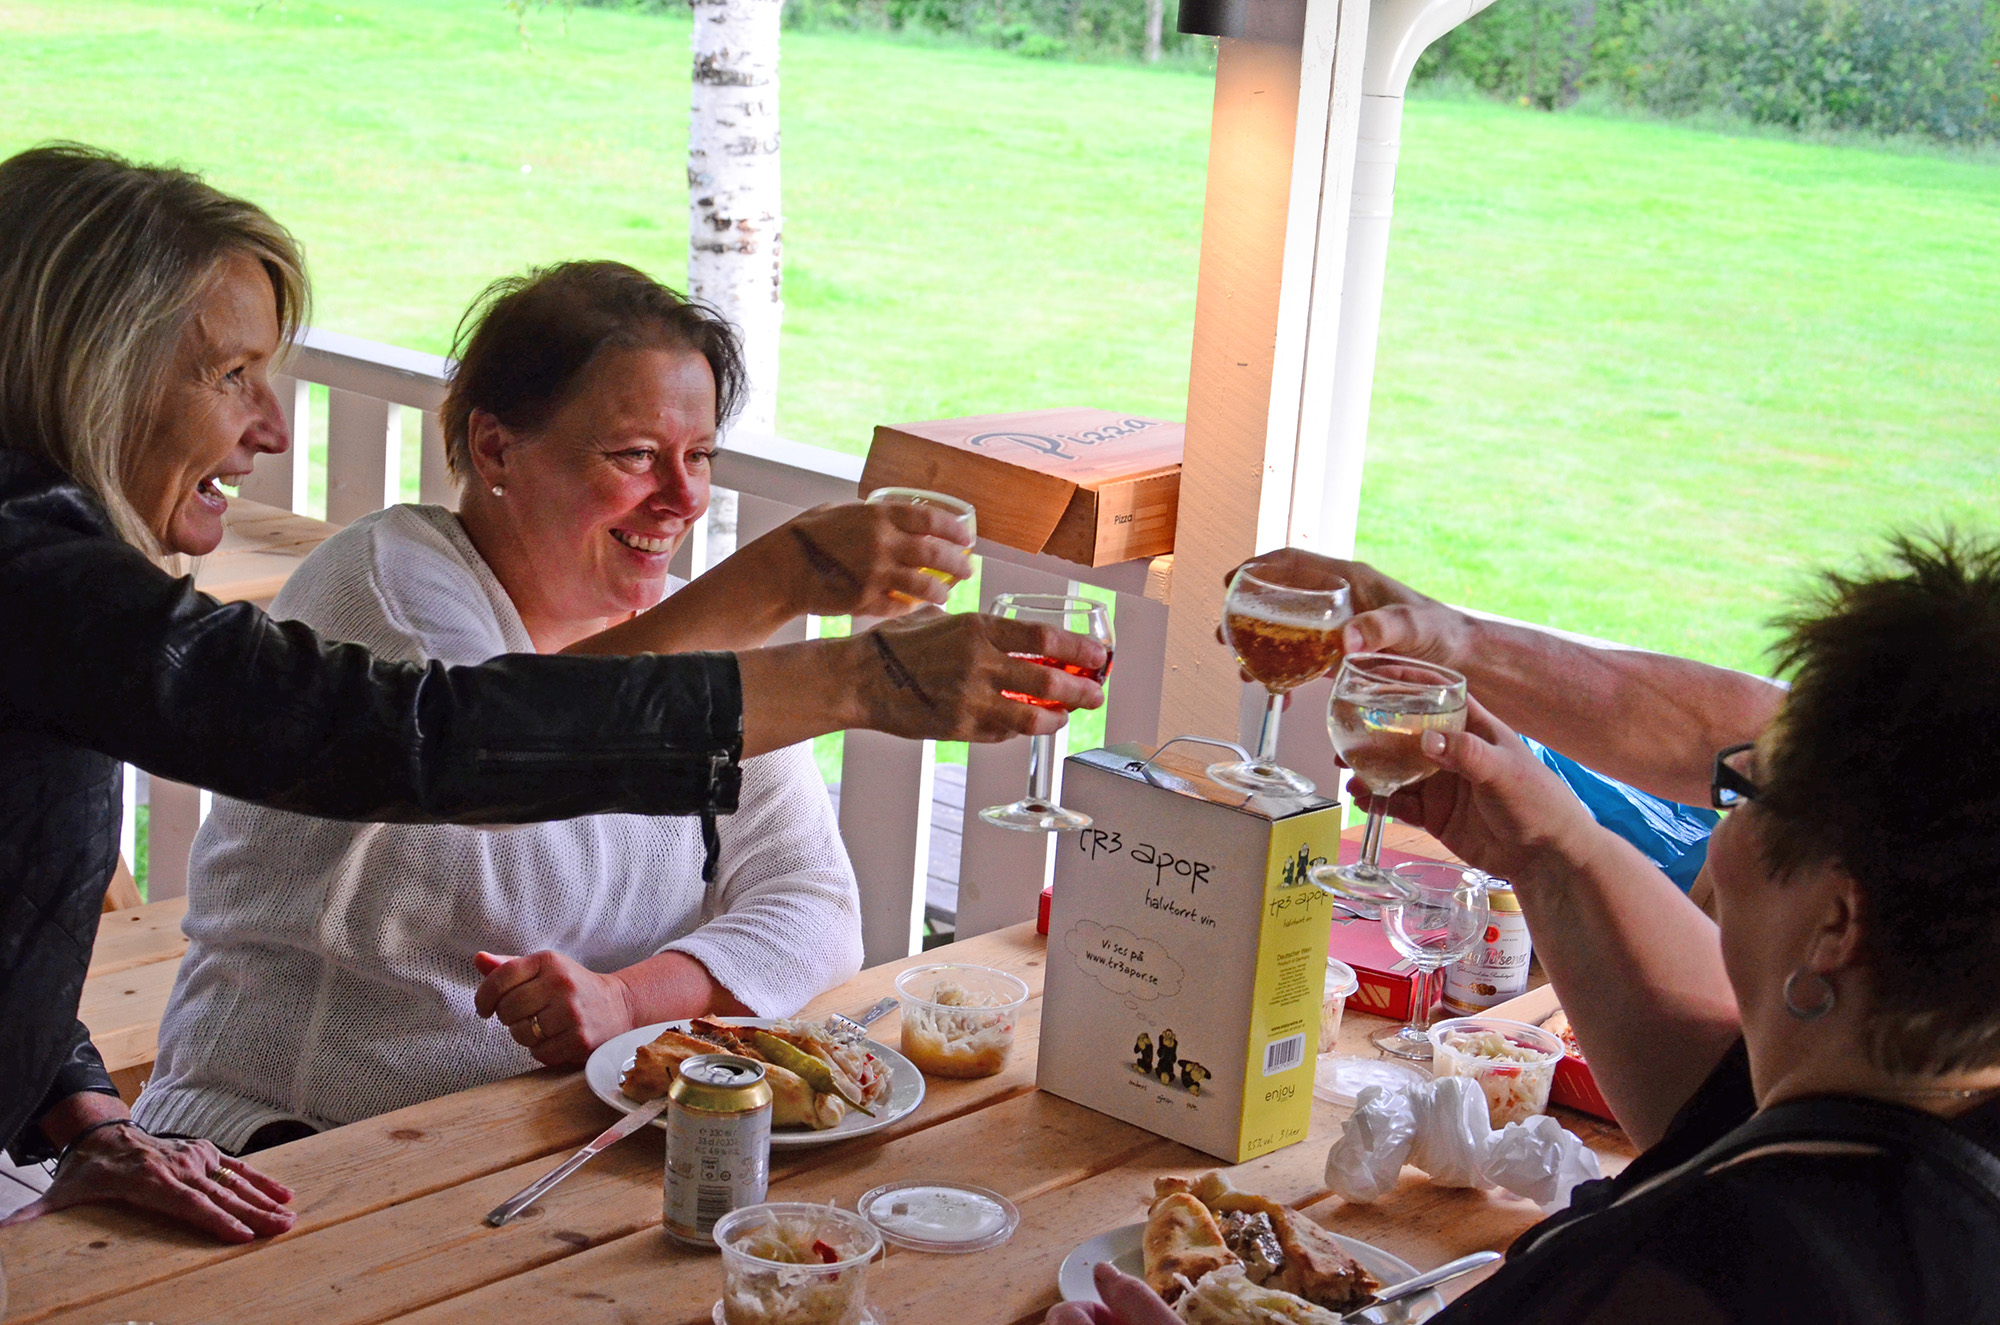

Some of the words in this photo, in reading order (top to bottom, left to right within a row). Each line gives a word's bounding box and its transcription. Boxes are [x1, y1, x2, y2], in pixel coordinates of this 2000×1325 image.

[968, 418, 1159, 462] Pizza
[1114, 513, 1134, 526] Pizza
[1200, 915, 1216, 929] vin
[1113, 943, 1128, 957] ses
[1130, 950, 1144, 963] på
[1483, 947, 1527, 966] Pilsener
[1265, 1084, 1295, 1102] enjoy
